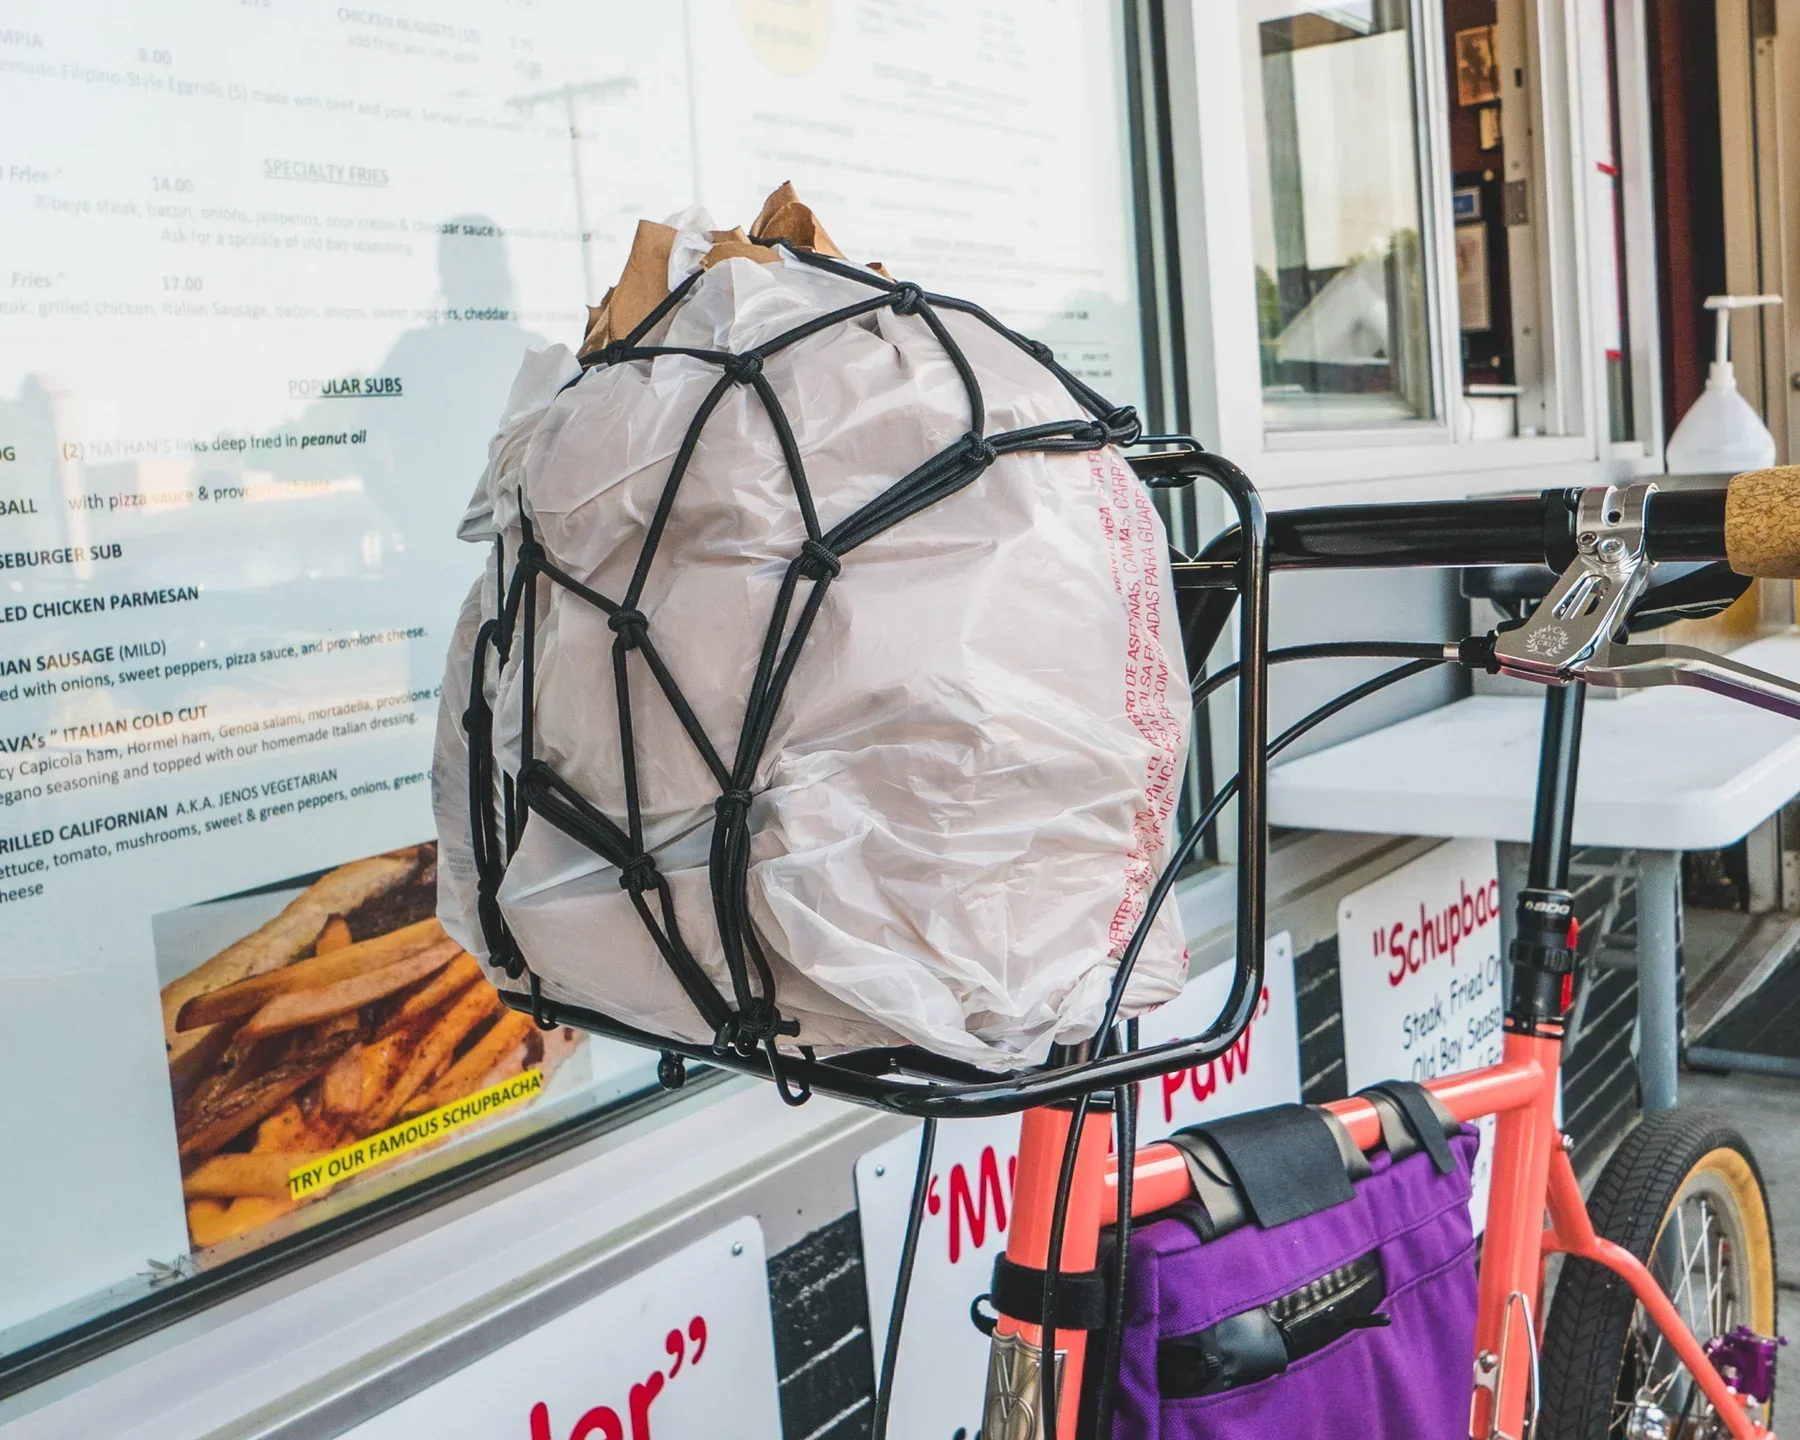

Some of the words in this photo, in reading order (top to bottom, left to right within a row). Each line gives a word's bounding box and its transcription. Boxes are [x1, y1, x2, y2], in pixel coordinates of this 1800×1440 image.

[152, 175, 194, 194] 14.00
[264, 157, 344, 182] SPECIALTY
[349, 165, 390, 186] FRIES
[462, 222, 495, 238] sauce
[11, 271, 52, 289] Fries
[162, 275, 203, 293] 17.00
[464, 305, 509, 322] cheddar
[288, 377, 361, 397] POPULAR
[365, 376, 403, 395] SUBS
[63, 442, 85, 461] (2)
[90, 438, 172, 457] NATHAN'S
[176, 436, 208, 453] links
[211, 435, 247, 453] deep
[250, 432, 282, 449] fried
[285, 432, 298, 448] in
[301, 431, 347, 450] peanut
[351, 429, 367, 445] oil
[69, 493, 104, 511] with
[109, 493, 147, 511] pizza
[152, 490, 194, 504] sauce
[198, 485, 208, 501] &
[90, 543, 123, 561] SUB
[1119, 516, 1139, 574] CAMAS,
[1141, 547, 1158, 587] PARA
[33, 596, 106, 619] CHICKEN
[110, 586, 200, 611] PARMESAN
[23, 680, 57, 699] with
[61, 671, 115, 692] onions,
[119, 667, 161, 684] sweet
[164, 657, 222, 680] peppers,
[226, 652, 257, 670] pizza
[260, 644, 299, 660] sauce,
[301, 640, 323, 656] and
[327, 631, 385, 655] provolone
[36, 646, 115, 672] SAUSAGE
[119, 640, 167, 662] (MILD)
[1125, 662, 1138, 686] DE
[1139, 665, 1155, 717] BOLSA
[19, 753, 83, 776] Capicola
[87, 746, 124, 764] ham,
[127, 734, 178, 755] Hormel
[182, 726, 216, 745] ham,
[219, 720, 260, 739] Genoa
[262, 713, 307, 734] salami,
[308, 700, 374, 723] mortadella,
[376, 687, 431, 711] provolone
[63, 719, 128, 743] ITALIAN
[132, 711, 174, 731] COLD
[178, 704, 208, 722] CUT
[46, 771, 120, 795] seasoning
[123, 762, 150, 780] and
[153, 752, 202, 773] topped
[205, 747, 234, 763] with
[237, 743, 259, 758] our
[261, 729, 330, 753] homemade
[332, 719, 368, 739] Italian
[53, 843, 112, 867] tomato,
[116, 825, 202, 853] mushrooms,
[205, 812, 243, 833] sweet
[246, 809, 257, 823] &
[259, 801, 295, 822] green
[298, 789, 348, 813] peppers,
[350, 780, 392, 798] onions,
[393, 771, 425, 791] green
[59, 804, 169, 841] CALIFORNIAN
[176, 797, 216, 816] A.K.A.
[218, 786, 259, 809] JENOS
[261, 768, 338, 797] VEGETARIAN
[1449, 968, 1484, 1018] Fried
[1440, 1036, 1463, 1072] Bay
[286, 1167, 323, 1195] TRY
[327, 1149, 365, 1178] OUR
[369, 1118, 439, 1161] FAMOUS
